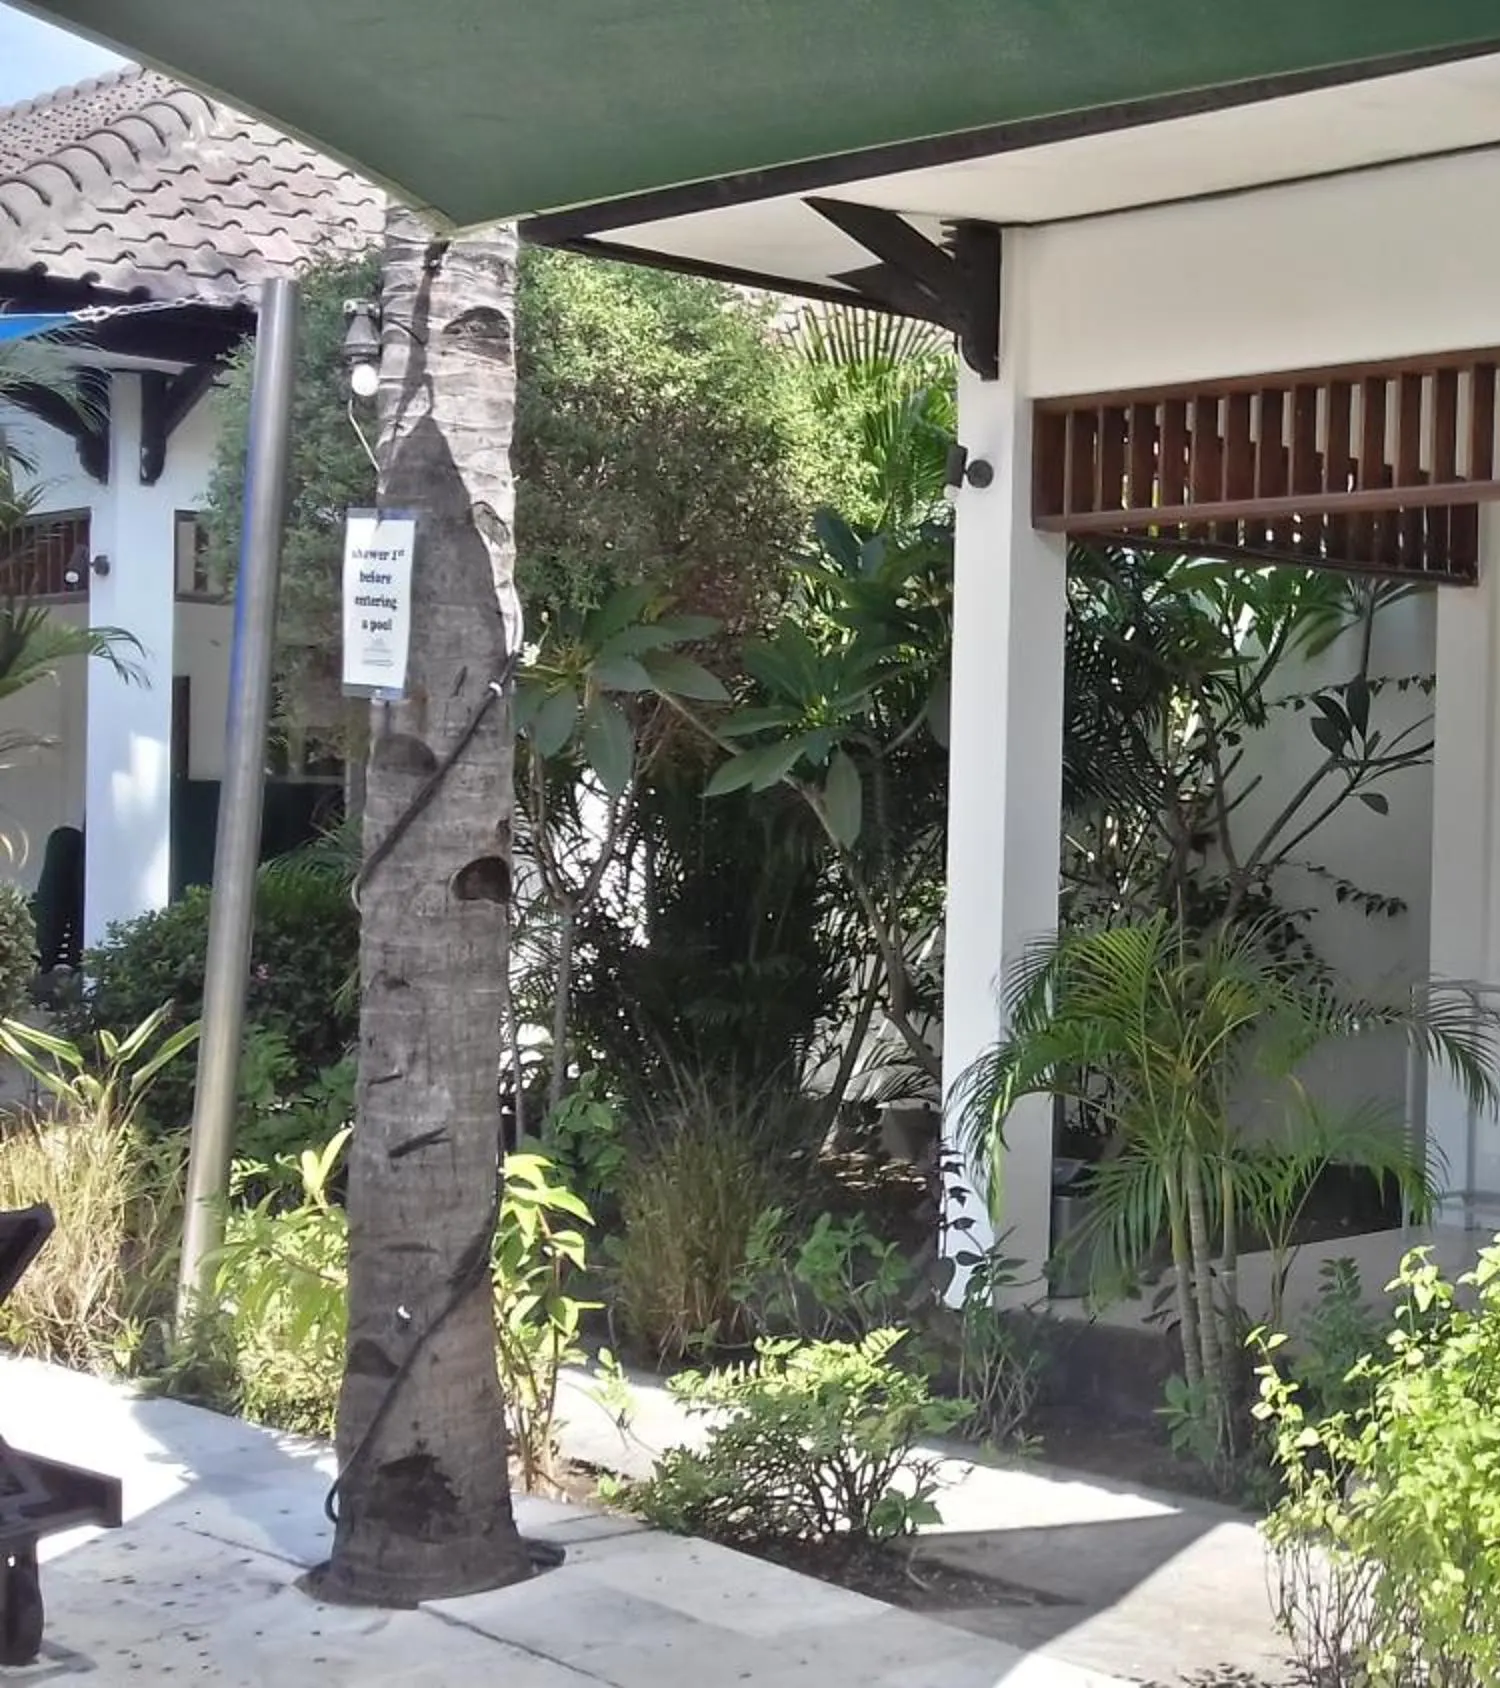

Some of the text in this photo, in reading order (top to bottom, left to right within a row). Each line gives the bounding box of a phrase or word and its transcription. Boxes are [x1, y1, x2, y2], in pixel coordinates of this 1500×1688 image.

[359, 570, 392, 584] before
[354, 595, 397, 611] entering
[361, 619, 392, 633] a pool
